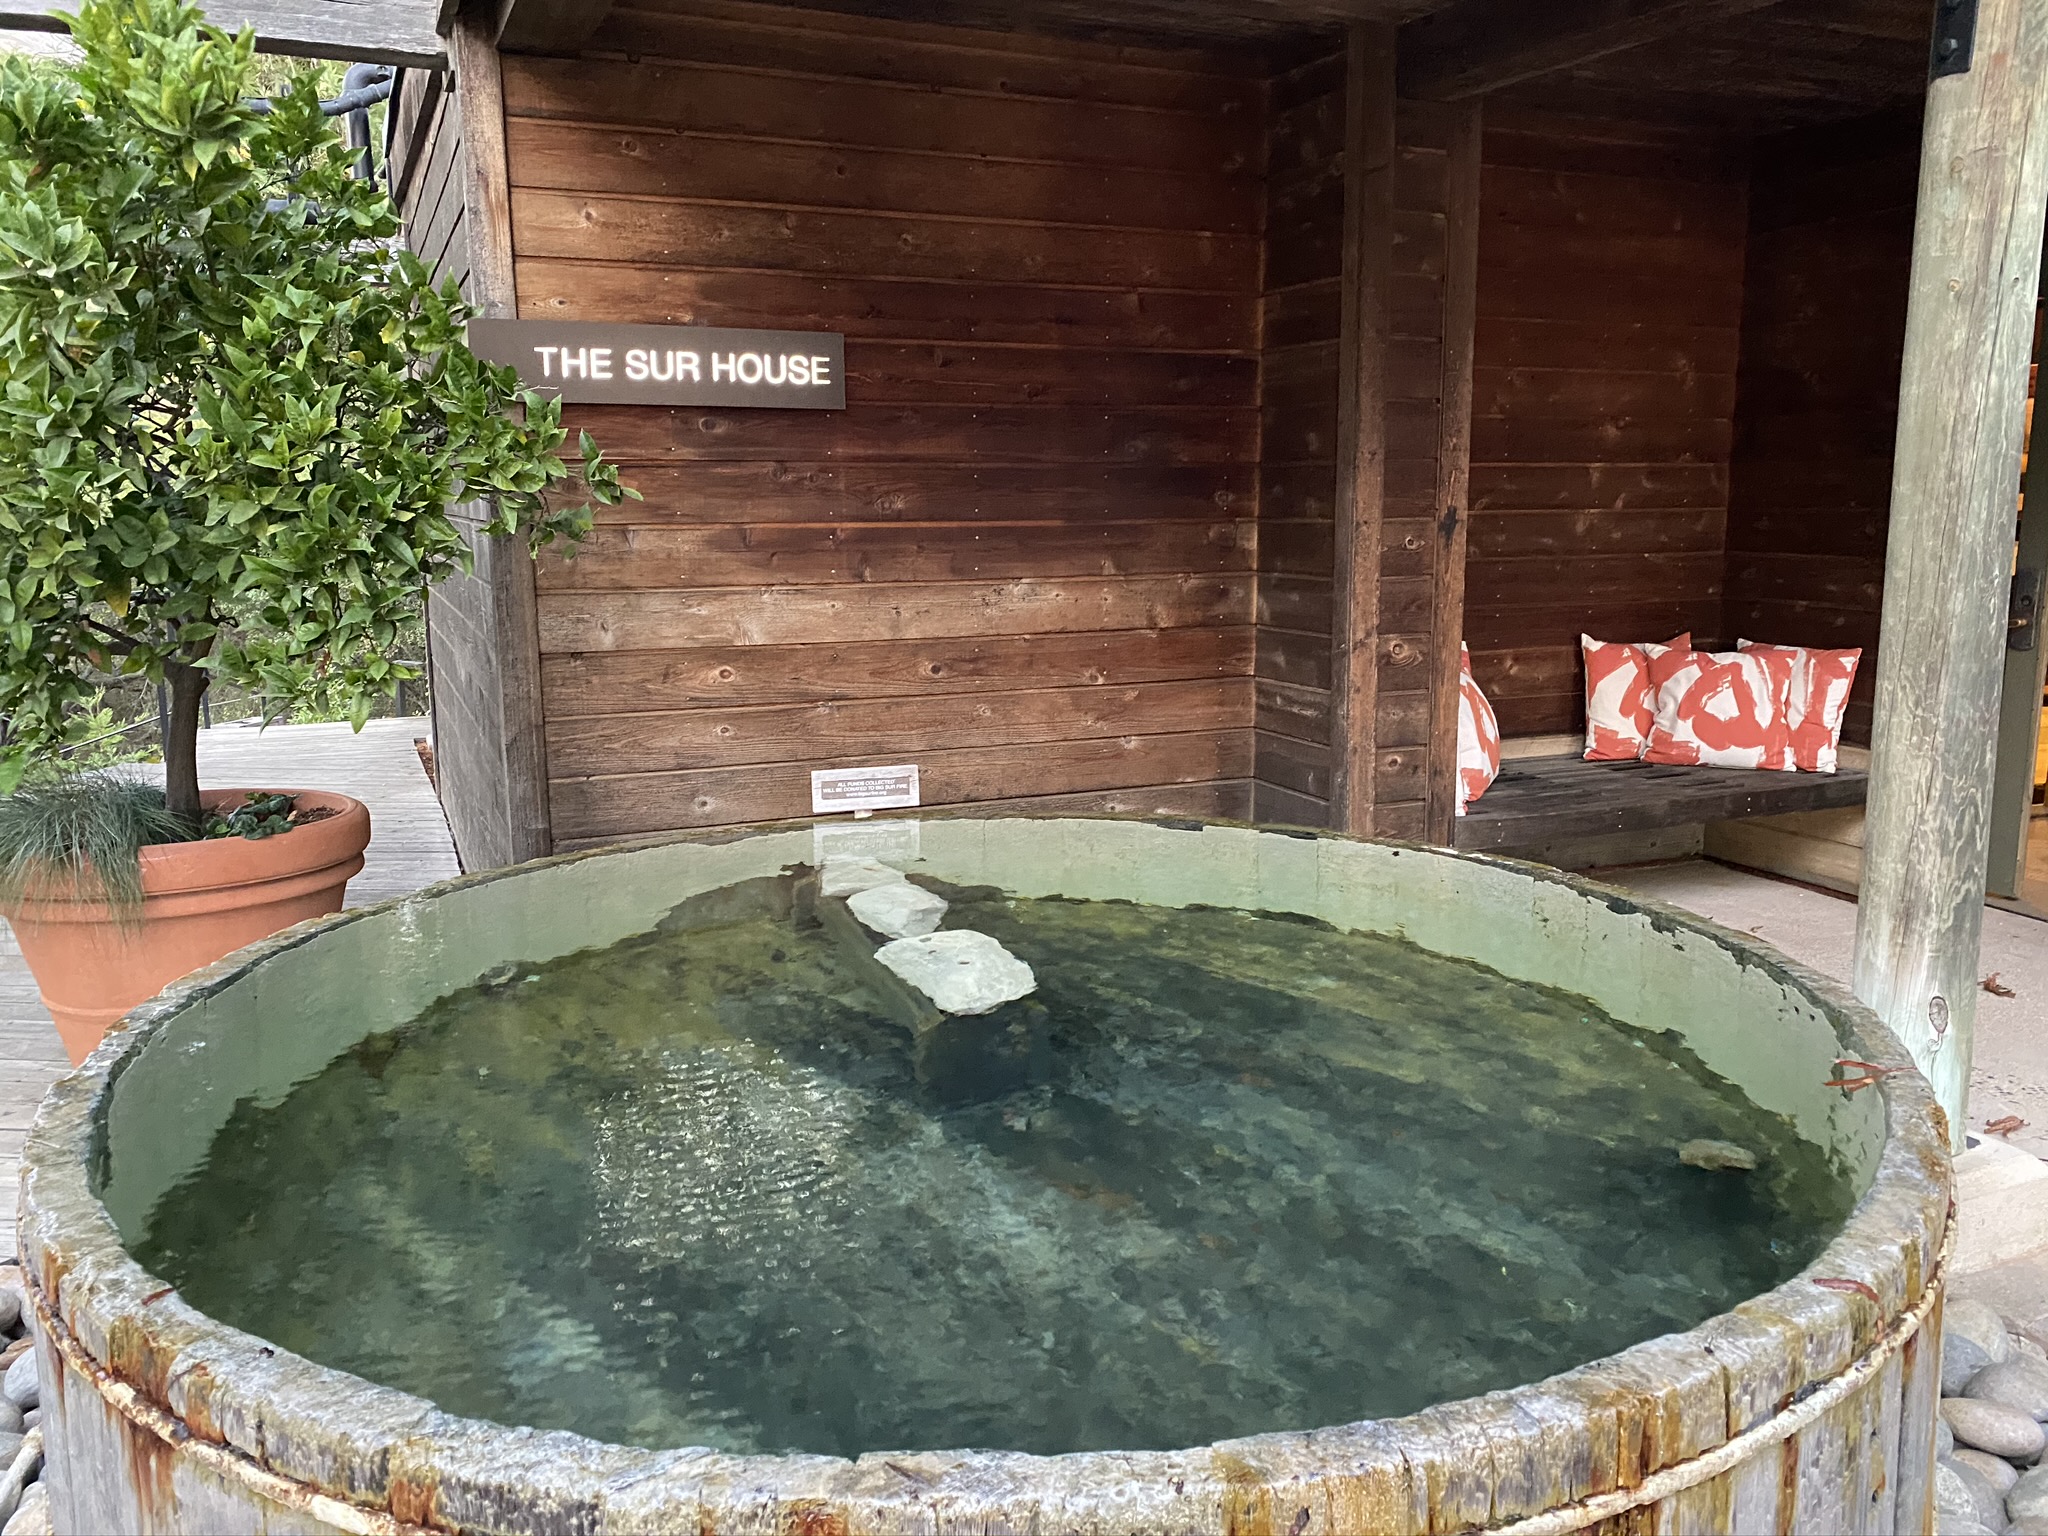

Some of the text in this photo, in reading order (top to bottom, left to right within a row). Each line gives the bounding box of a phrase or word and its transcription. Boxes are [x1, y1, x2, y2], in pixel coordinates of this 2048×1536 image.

[533, 347, 831, 385] THE SUR HOUSE
